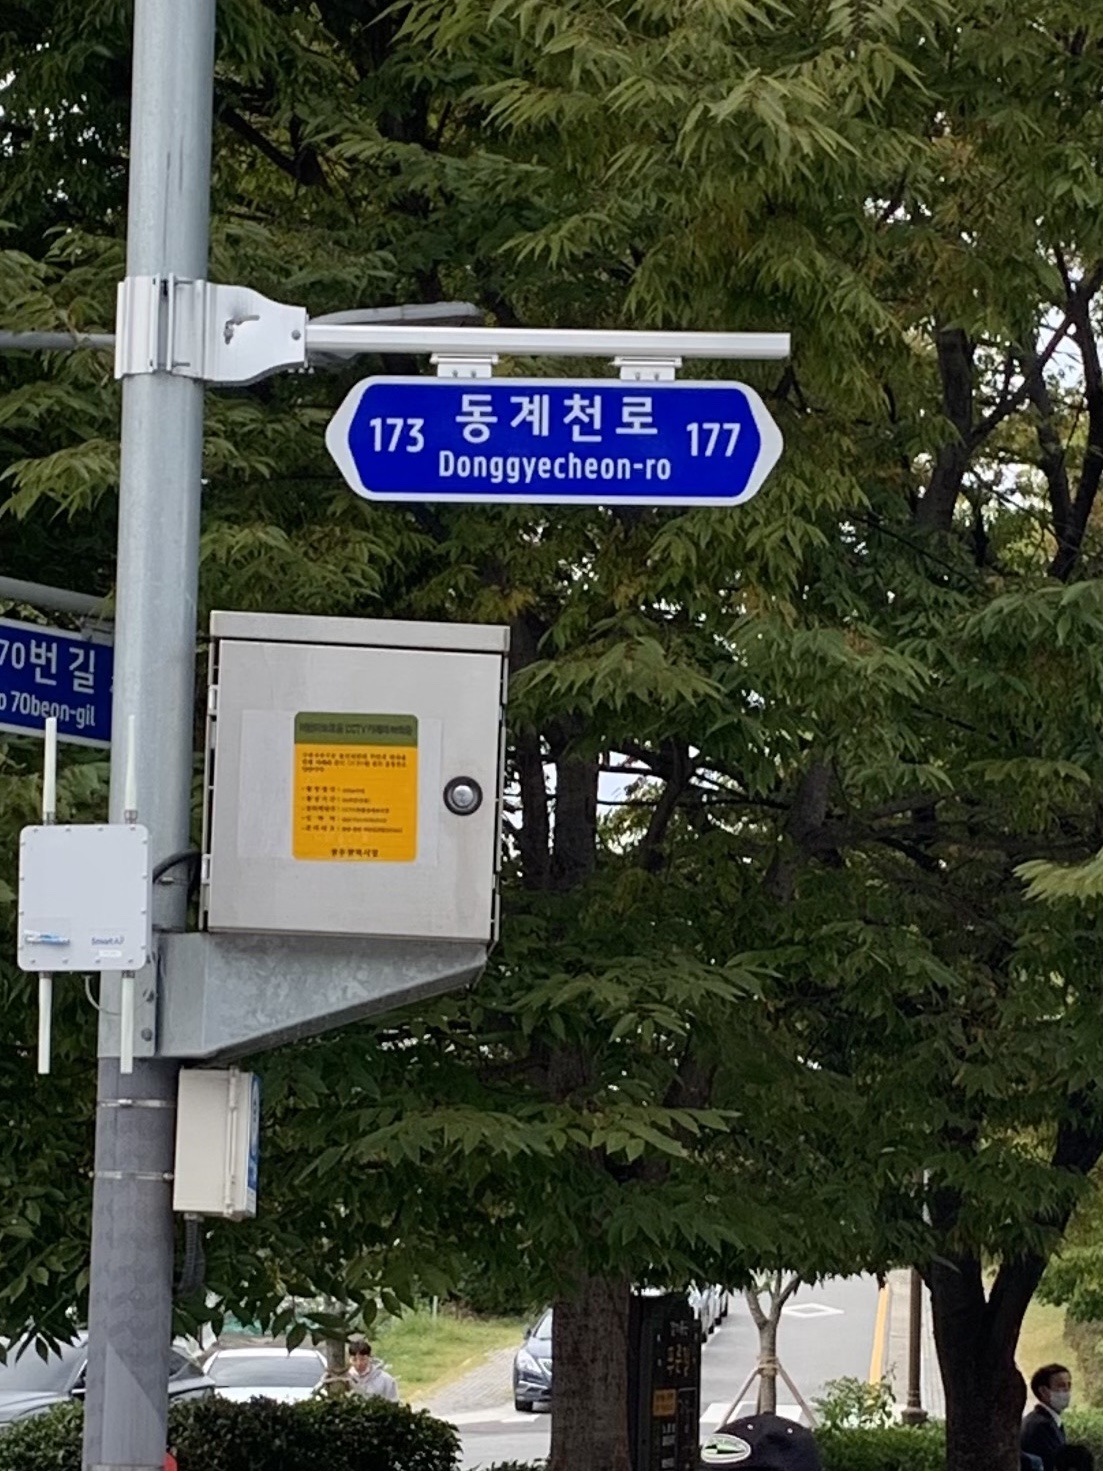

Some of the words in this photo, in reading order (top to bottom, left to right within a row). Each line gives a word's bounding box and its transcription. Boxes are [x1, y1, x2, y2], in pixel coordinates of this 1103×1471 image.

[369, 417, 425, 453] 173
[456, 394, 658, 443] 동계천로
[686, 422, 741, 458] 177
[438, 450, 671, 483] Donggyecheon-ro
[10, 691, 96, 729] 70beon-gil
